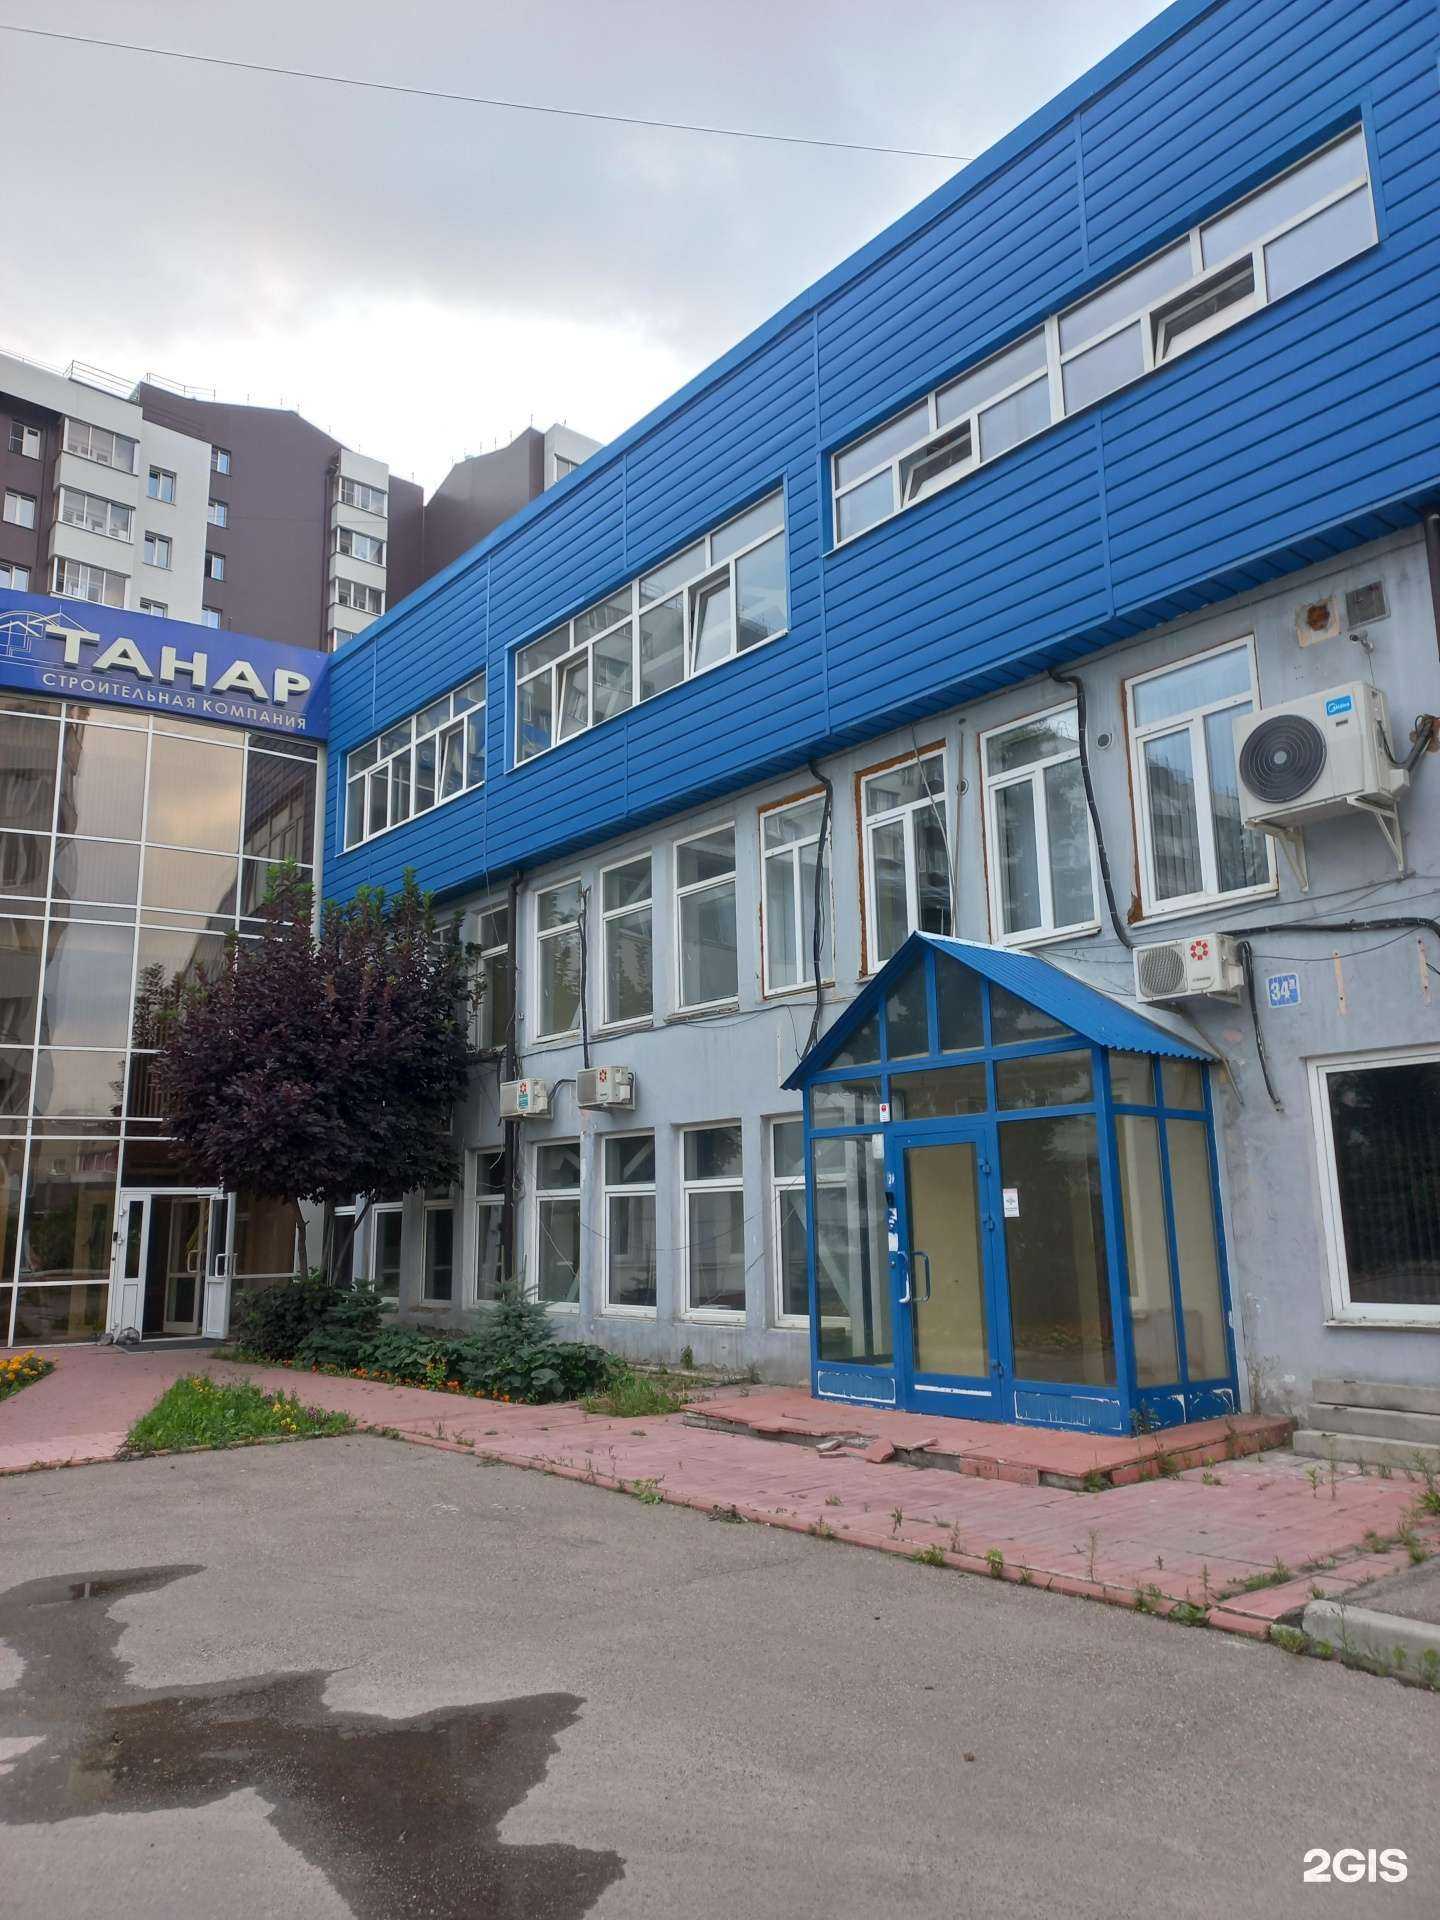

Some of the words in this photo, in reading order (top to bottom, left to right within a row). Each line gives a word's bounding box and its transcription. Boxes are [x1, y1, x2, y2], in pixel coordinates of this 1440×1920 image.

[45, 624, 312, 705] ТАНАР
[42, 672, 196, 709] СТРОИТЕЛЬНАЯ
[202, 699, 306, 730] КОМПАНИЯ
